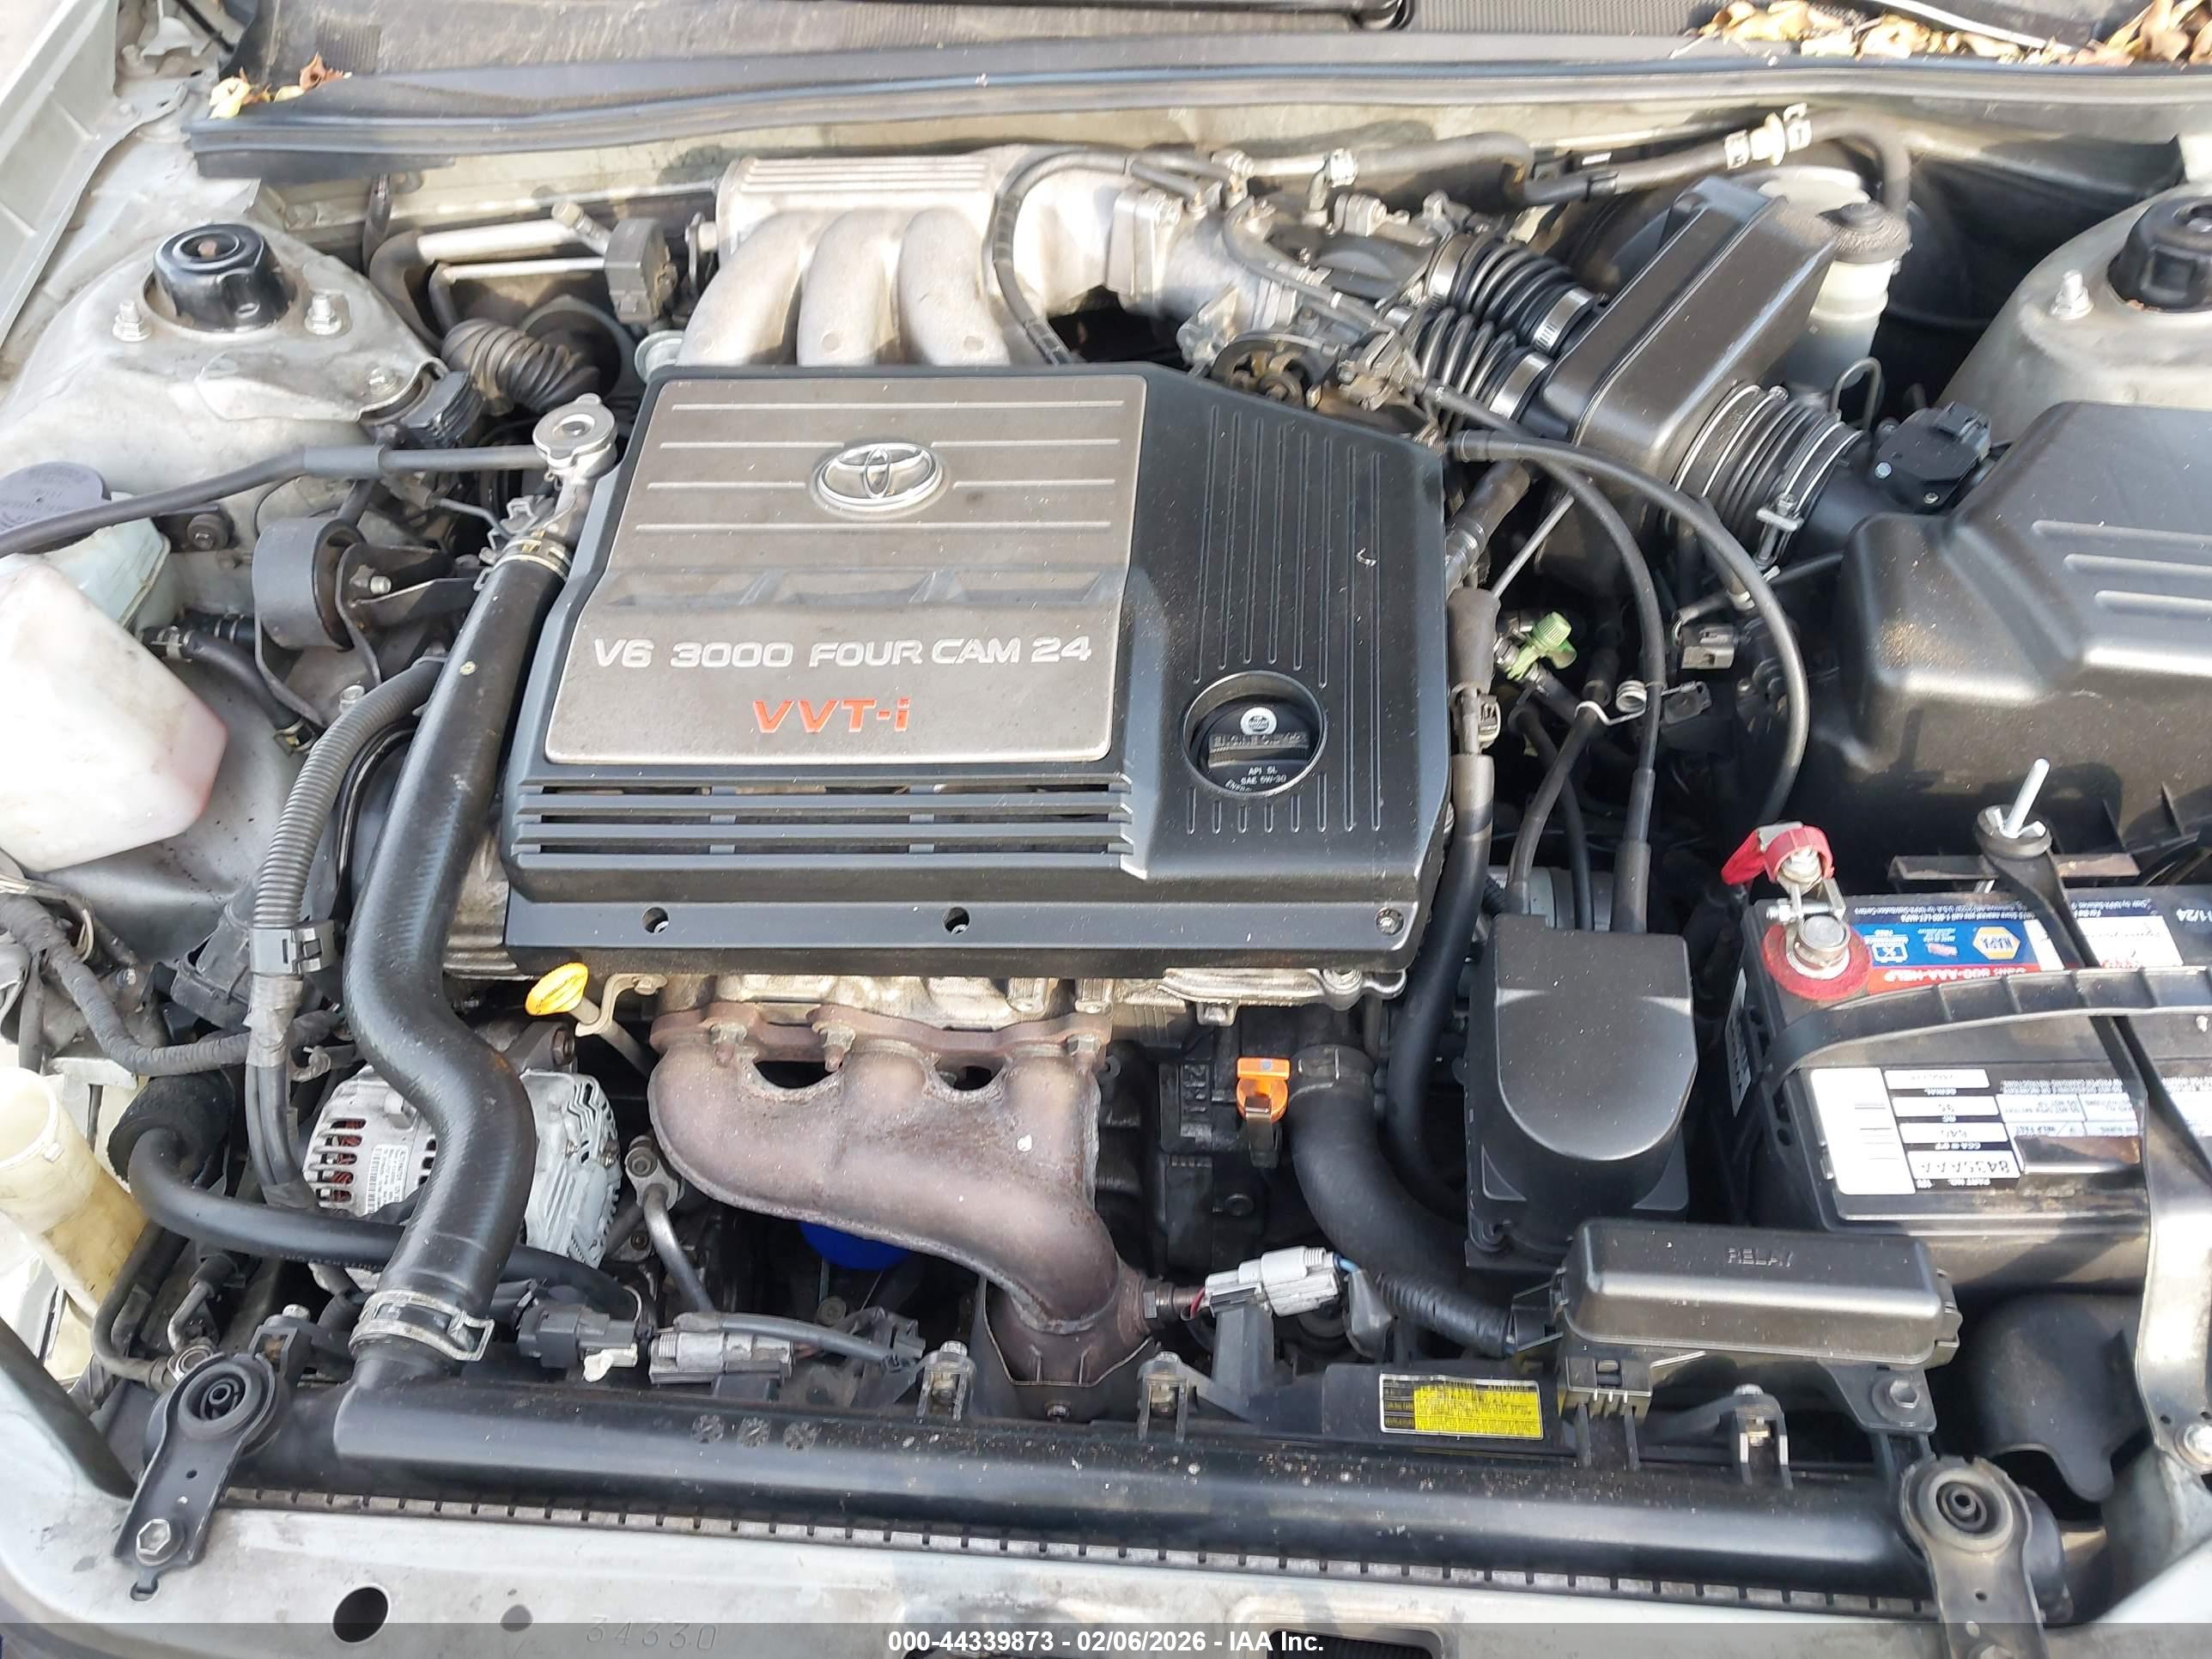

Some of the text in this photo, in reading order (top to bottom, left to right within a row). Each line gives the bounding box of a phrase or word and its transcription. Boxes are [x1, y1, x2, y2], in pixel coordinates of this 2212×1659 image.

[594, 635, 1092, 668] V6 3000 FOUR CAM 24
[751, 697, 912, 734] VVT-i
[1979, 935, 2014, 950] NAPA
[1727, 1247, 1794, 1268] RELAY
